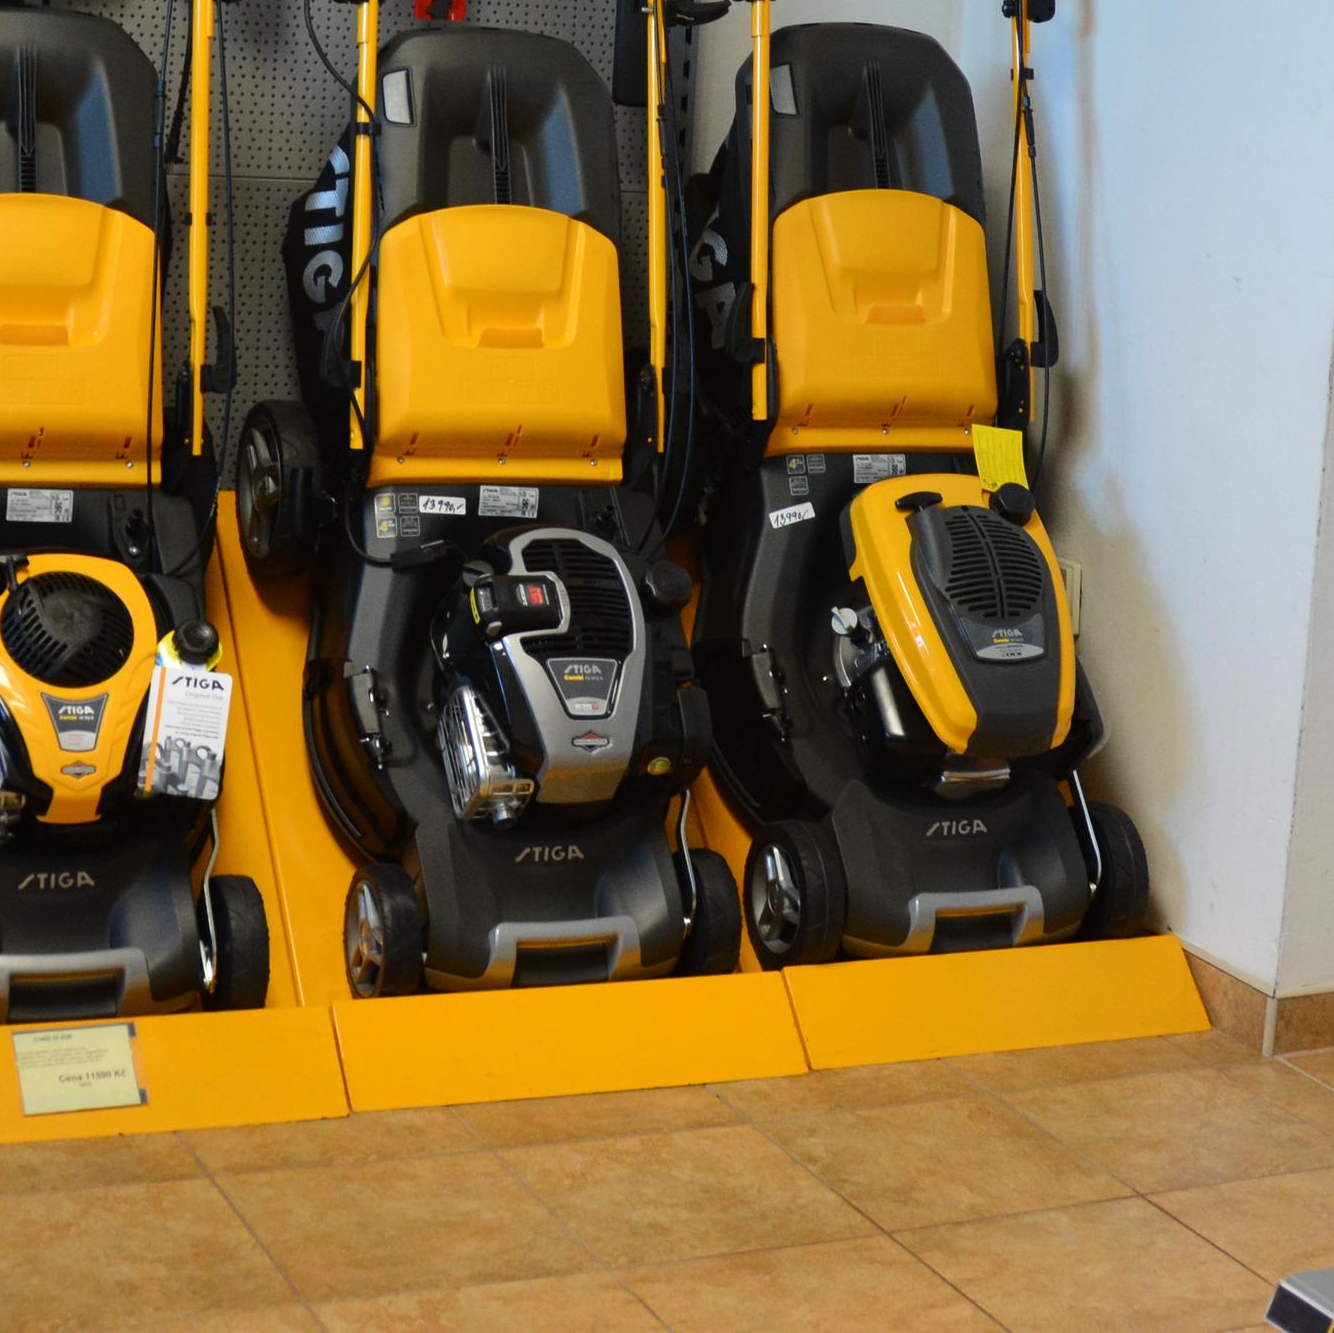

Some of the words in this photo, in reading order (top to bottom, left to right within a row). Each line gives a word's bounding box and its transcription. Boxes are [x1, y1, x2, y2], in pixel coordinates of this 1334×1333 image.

[992, 629, 1023, 638] STIGA
[564, 665, 602, 675] STIGA
[172, 676, 225, 691] STIGA
[58, 704, 95, 716] STIGA
[926, 820, 988, 837] STIGA
[515, 845, 585, 864] STIGA
[18, 871, 95, 891] STIGA
